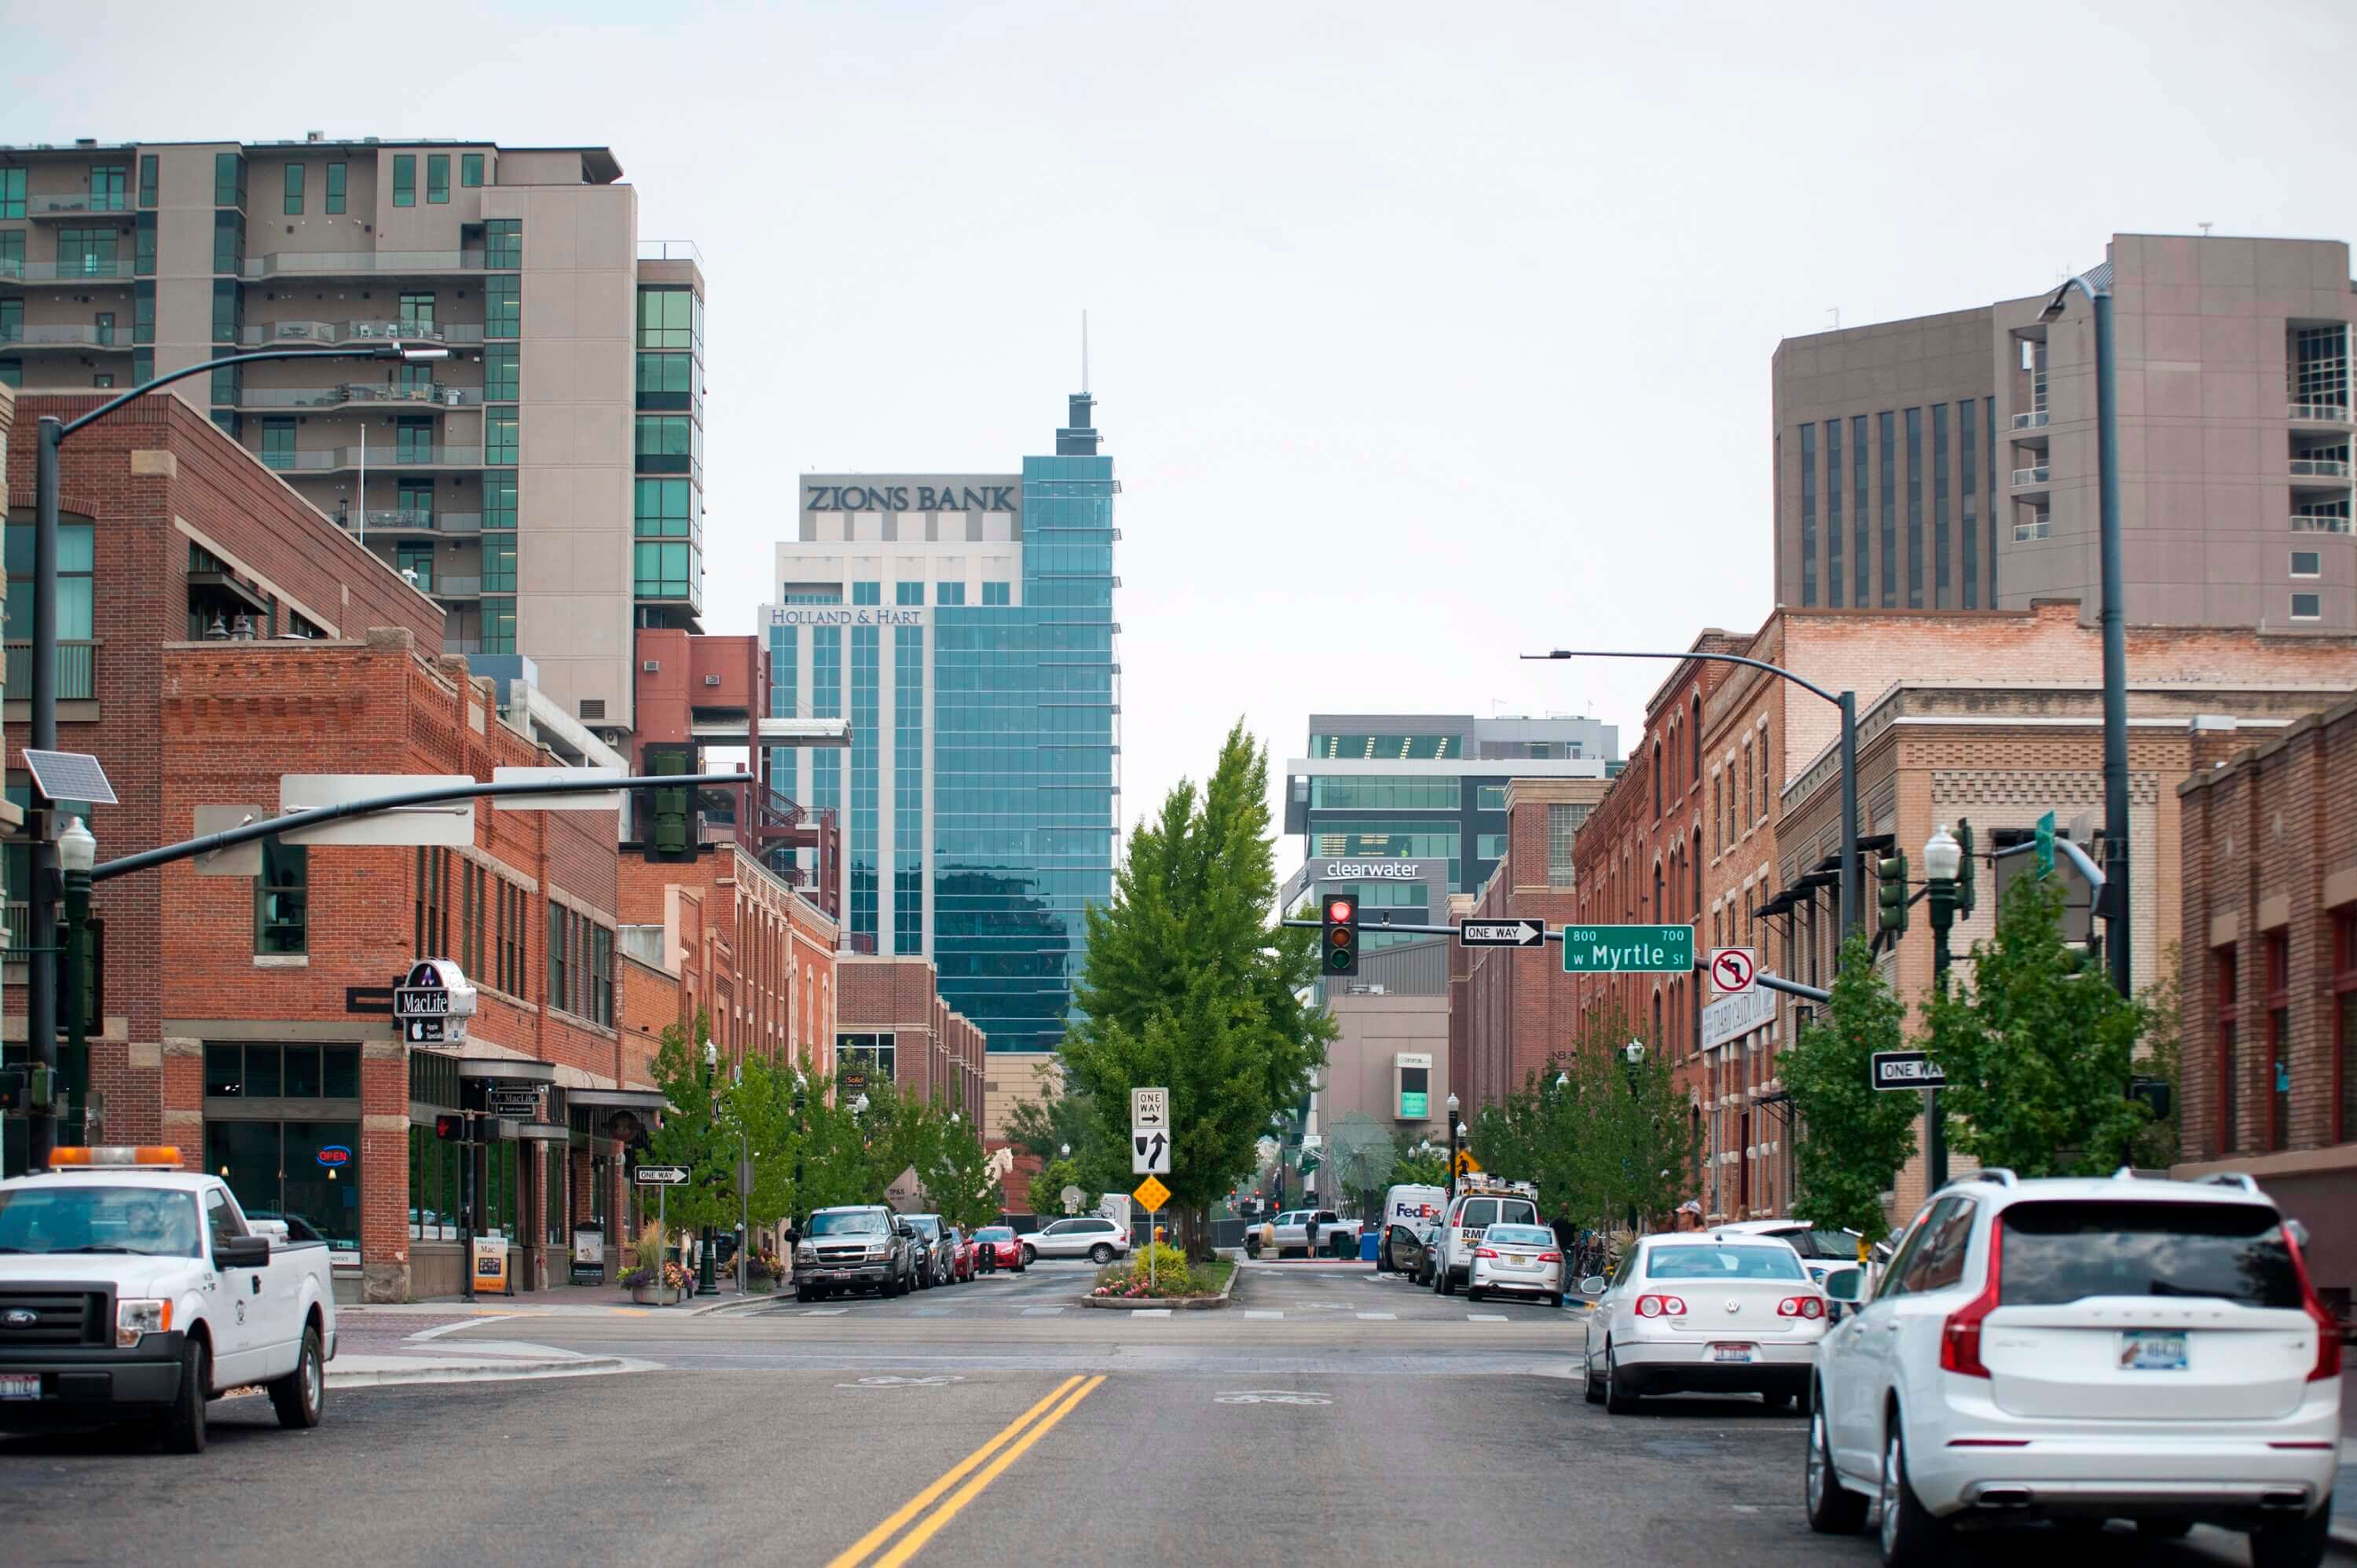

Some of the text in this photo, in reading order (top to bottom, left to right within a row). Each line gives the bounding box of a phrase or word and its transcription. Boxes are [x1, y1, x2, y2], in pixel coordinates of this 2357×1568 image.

[807, 485, 1017, 511] ZIONS BANK
[772, 610, 921, 624] HOLLAND & HART
[1327, 860, 1419, 877] clearwater
[1468, 928, 1519, 938] ONE WAY
[1573, 930, 1684, 942] 800 700
[1574, 943, 1684, 971] W Myrtle St
[403, 992, 448, 1013] MacLife
[1886, 1061, 1942, 1077] ONE WA
[1140, 1094, 1161, 1103] ONE
[1140, 1104, 1161, 1113] WAY
[319, 1151, 347, 1161] OPEN
[1396, 1203, 1441, 1218] FedEx
[480, 1245, 496, 1254] Mac
